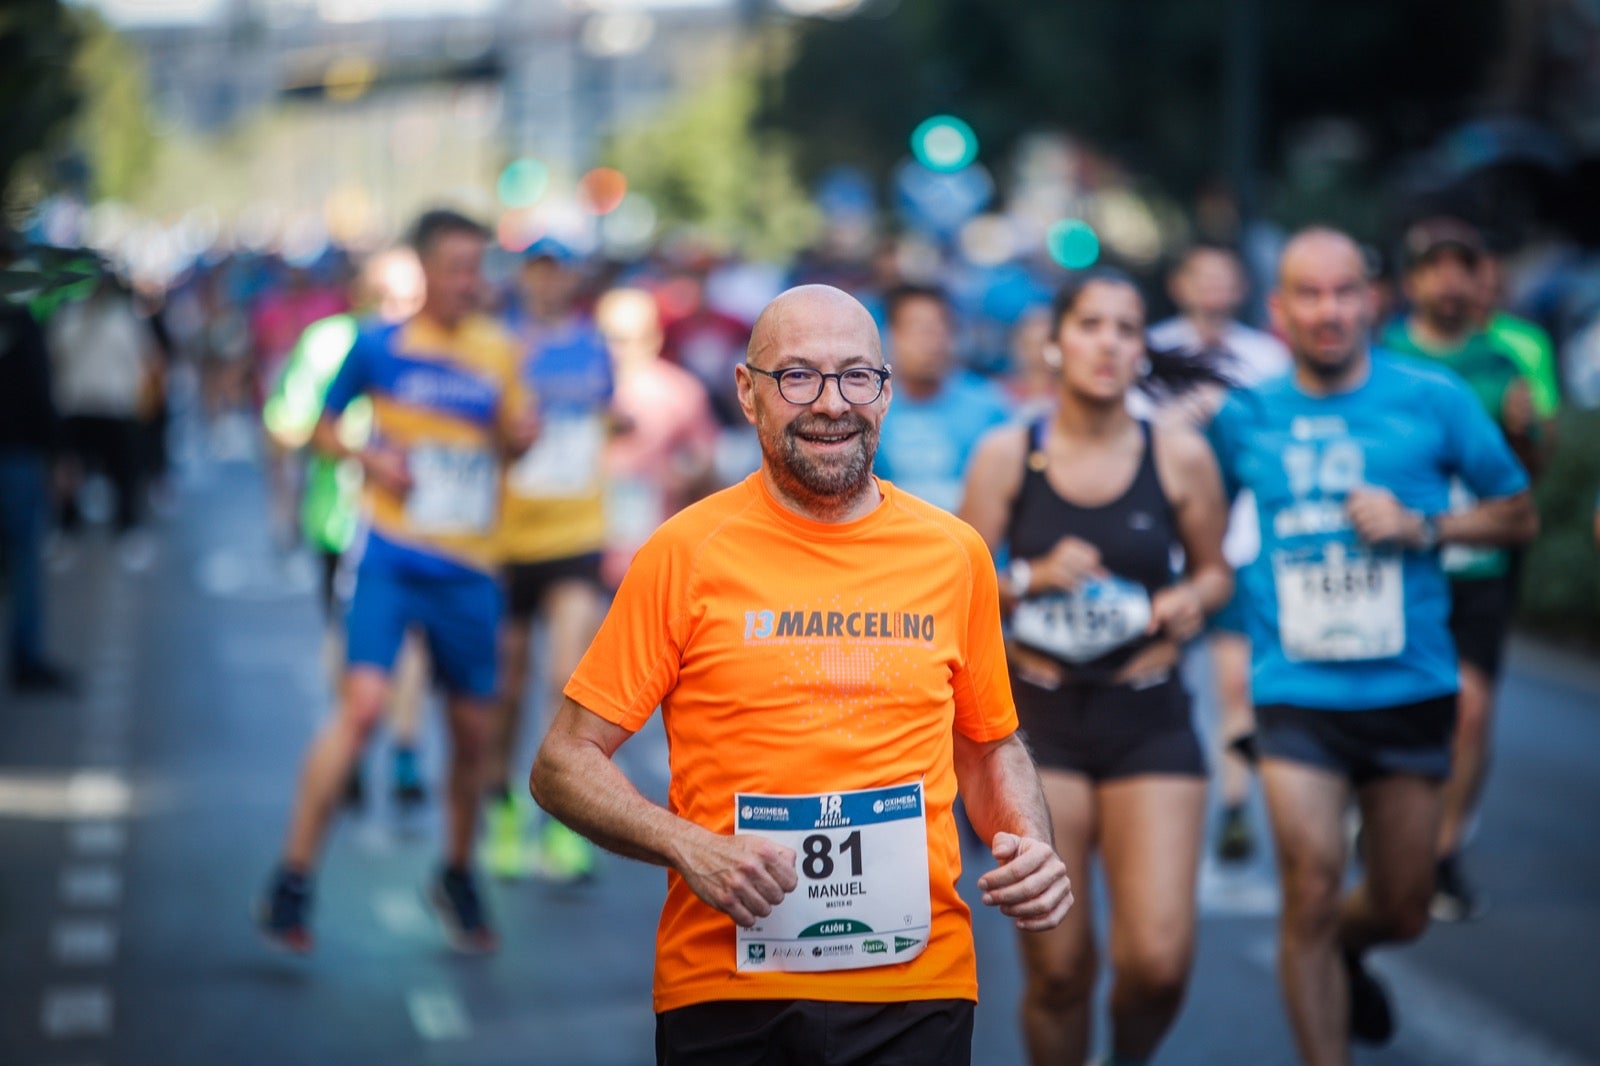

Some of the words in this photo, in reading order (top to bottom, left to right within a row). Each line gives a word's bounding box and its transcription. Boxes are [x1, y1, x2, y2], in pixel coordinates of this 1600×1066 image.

[820, 795, 842, 818] 18
[884, 794, 916, 806] OXIMESA
[753, 806, 789, 815] OXIMESA
[802, 829, 862, 880] 81
[808, 881, 867, 899] MANUEL
[820, 922, 845, 934] CAJÓN
[847, 922, 852, 933] 3
